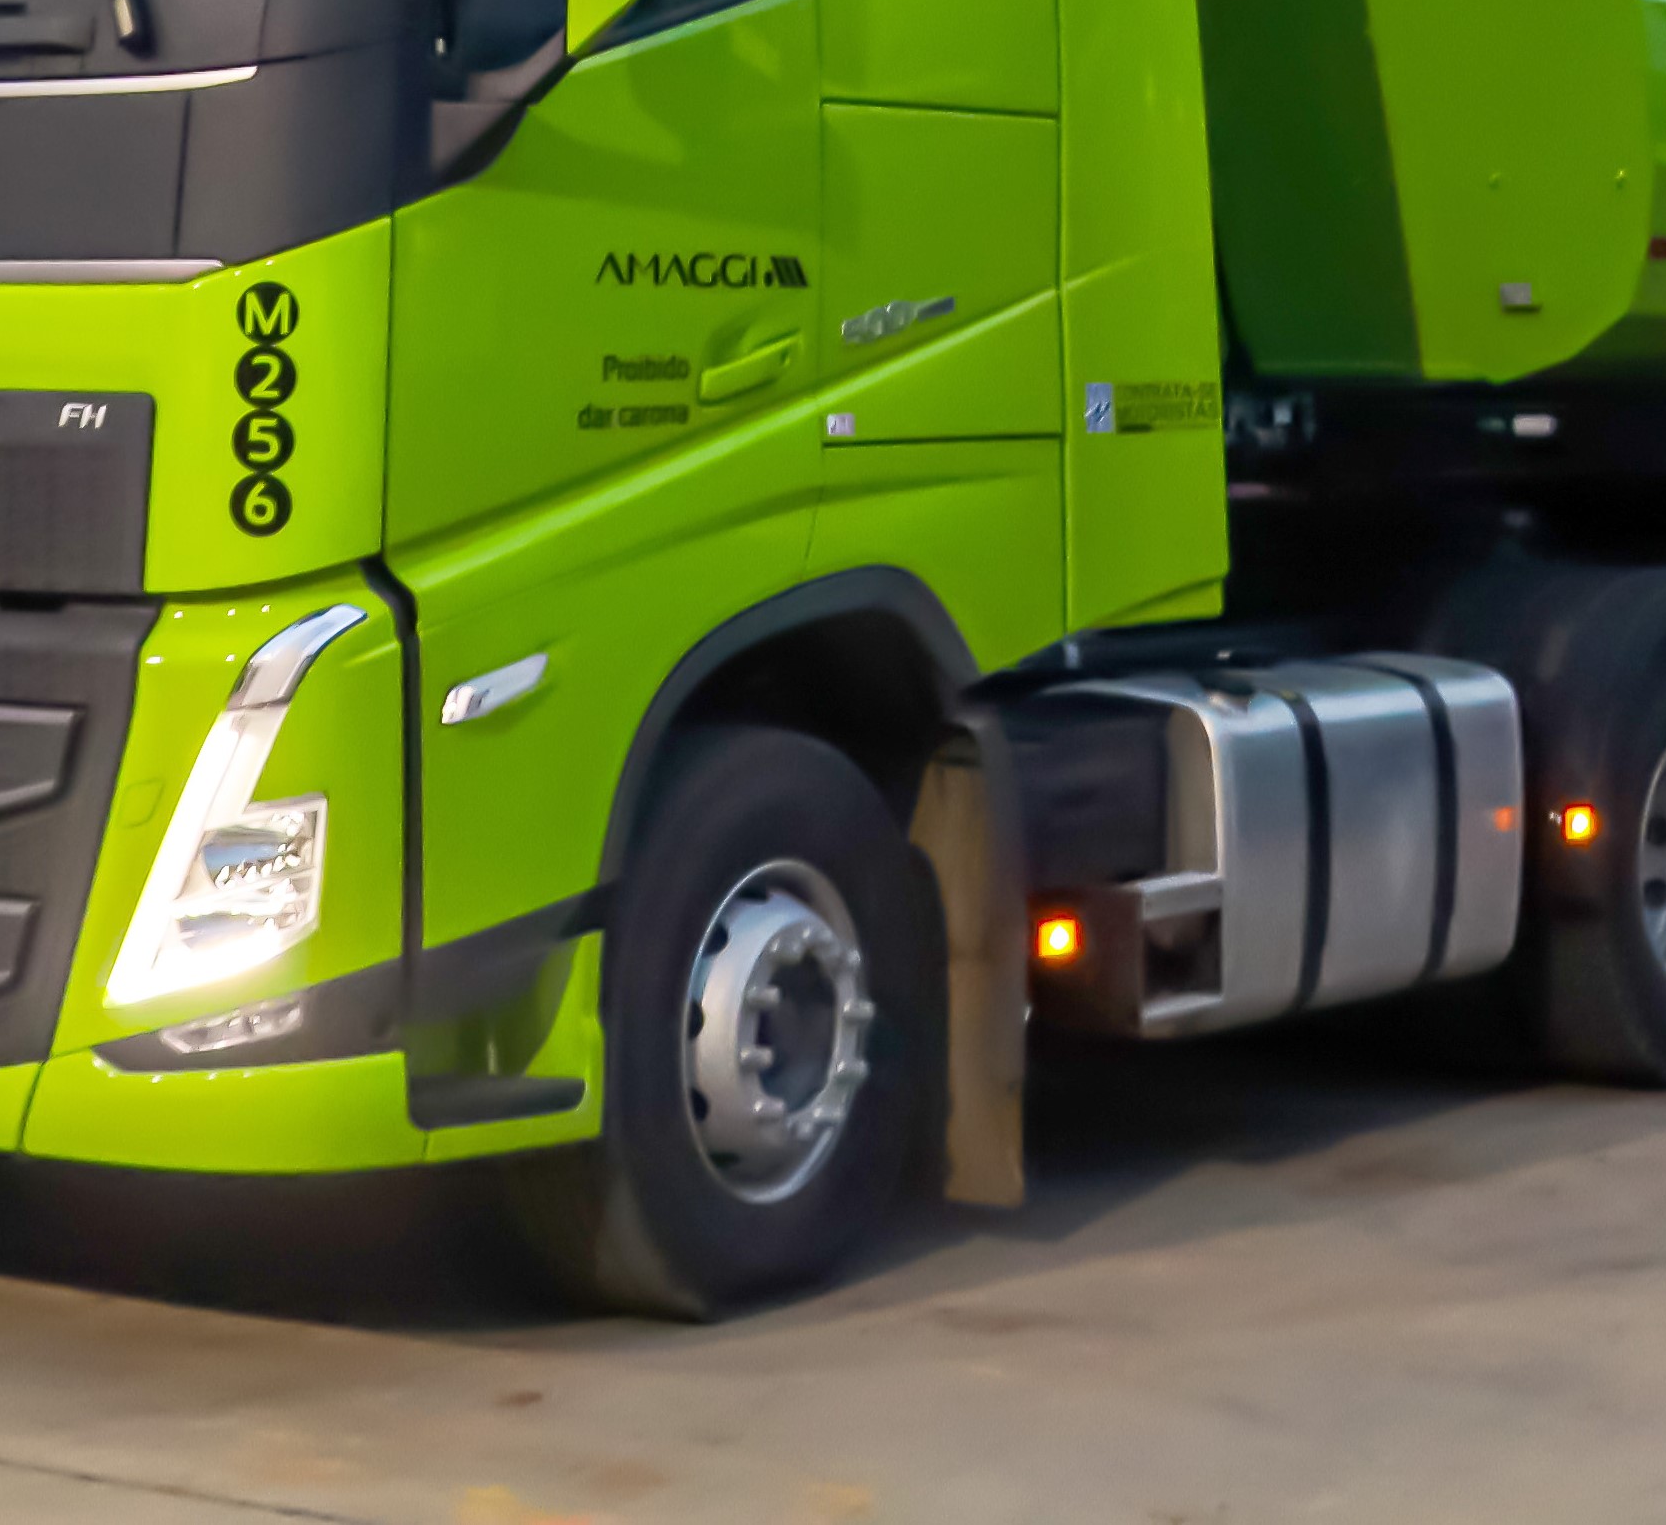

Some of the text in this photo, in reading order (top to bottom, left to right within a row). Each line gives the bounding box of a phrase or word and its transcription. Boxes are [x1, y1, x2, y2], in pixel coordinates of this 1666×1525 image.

[595, 252, 757, 288] AMAGGI
[602, 354, 691, 381] Proibido
[58, 402, 107, 429] FH
[577, 404, 689, 429] dar carona
